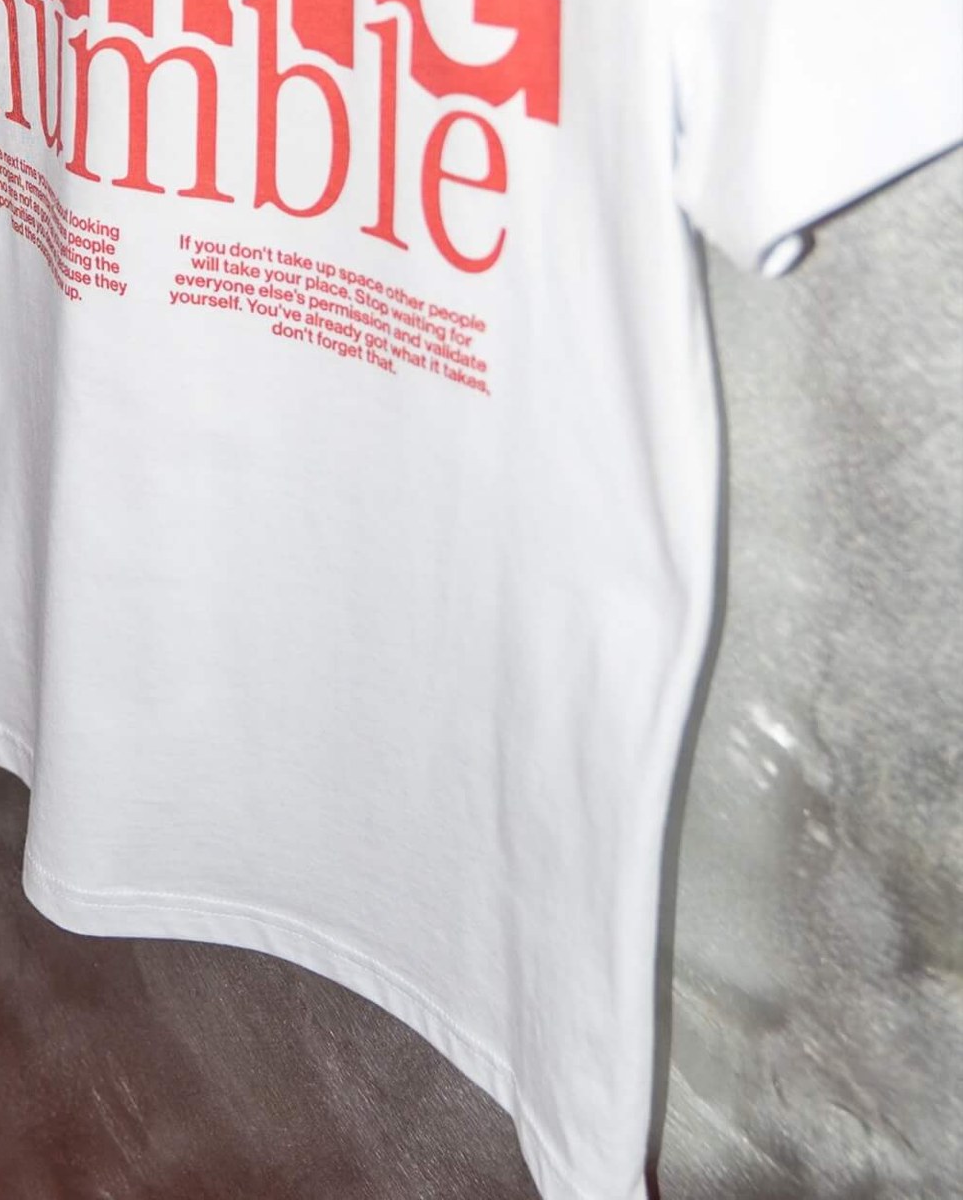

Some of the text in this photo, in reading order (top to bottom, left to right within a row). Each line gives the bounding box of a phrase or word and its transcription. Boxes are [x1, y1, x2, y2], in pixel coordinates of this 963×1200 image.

[4, 152, 18, 169] next
[20, 160, 37, 179] time
[69, 211, 120, 242] looking
[19, 193, 32, 208] not
[96, 258, 120, 274] the
[69, 233, 115, 255] people
[179, 234, 486, 333] If you don't take up space other people
[65, 285, 82, 301] up.
[95, 276, 127, 296] they
[174, 274, 487, 373] everyone else's permission and validate
[191, 256, 472, 348] will take your place. Stop waiting for
[169, 289, 243, 311] yourself.
[247, 298, 302, 323] You've
[305, 312, 362, 342] already
[365, 332, 388, 352] got
[390, 343, 427, 369] what
[429, 358, 441, 374] it
[271, 321, 397, 375] don't forget that.
